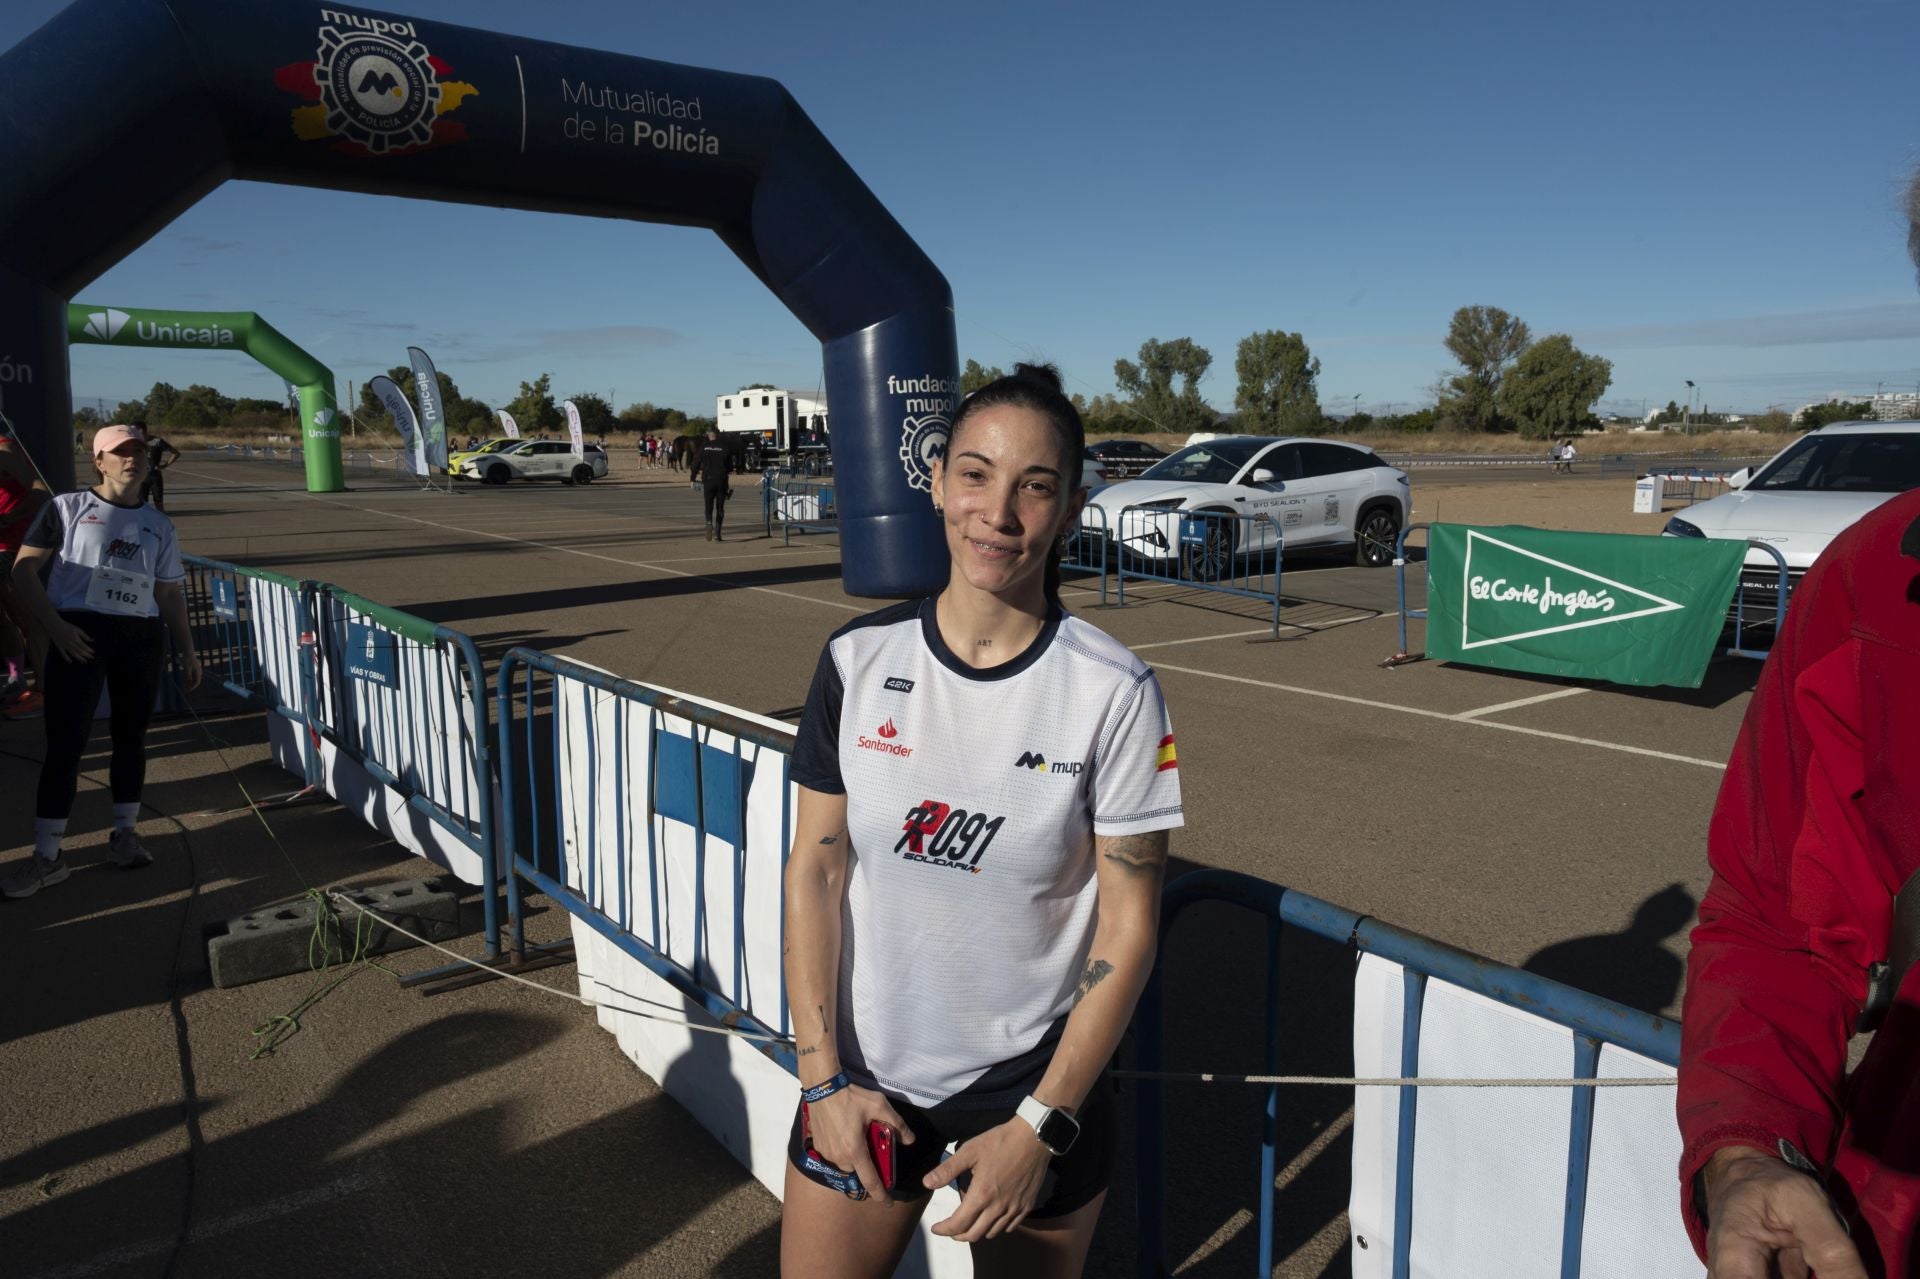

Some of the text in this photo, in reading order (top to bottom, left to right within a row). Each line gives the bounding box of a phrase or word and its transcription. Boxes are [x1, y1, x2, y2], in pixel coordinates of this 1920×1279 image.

[321, 9, 416, 37] mupol
[336, 53, 351, 102] Mutualidad
[361, 45, 403, 63] previsión
[403, 62, 421, 88] social
[562, 78, 701, 120] Mutualidad
[564, 112, 719, 155] de la Policía
[137, 321, 234, 347] Unicaja
[906, 395, 954, 416] mupol
[105, 589, 138, 605] 1162
[1470, 575, 1615, 616] El Corte Inglés
[886, 680, 912, 691] 42K
[857, 735, 913, 757] Santander
[1051, 761, 1085, 777] mup
[902, 852, 977, 872] SOLIDARIA
